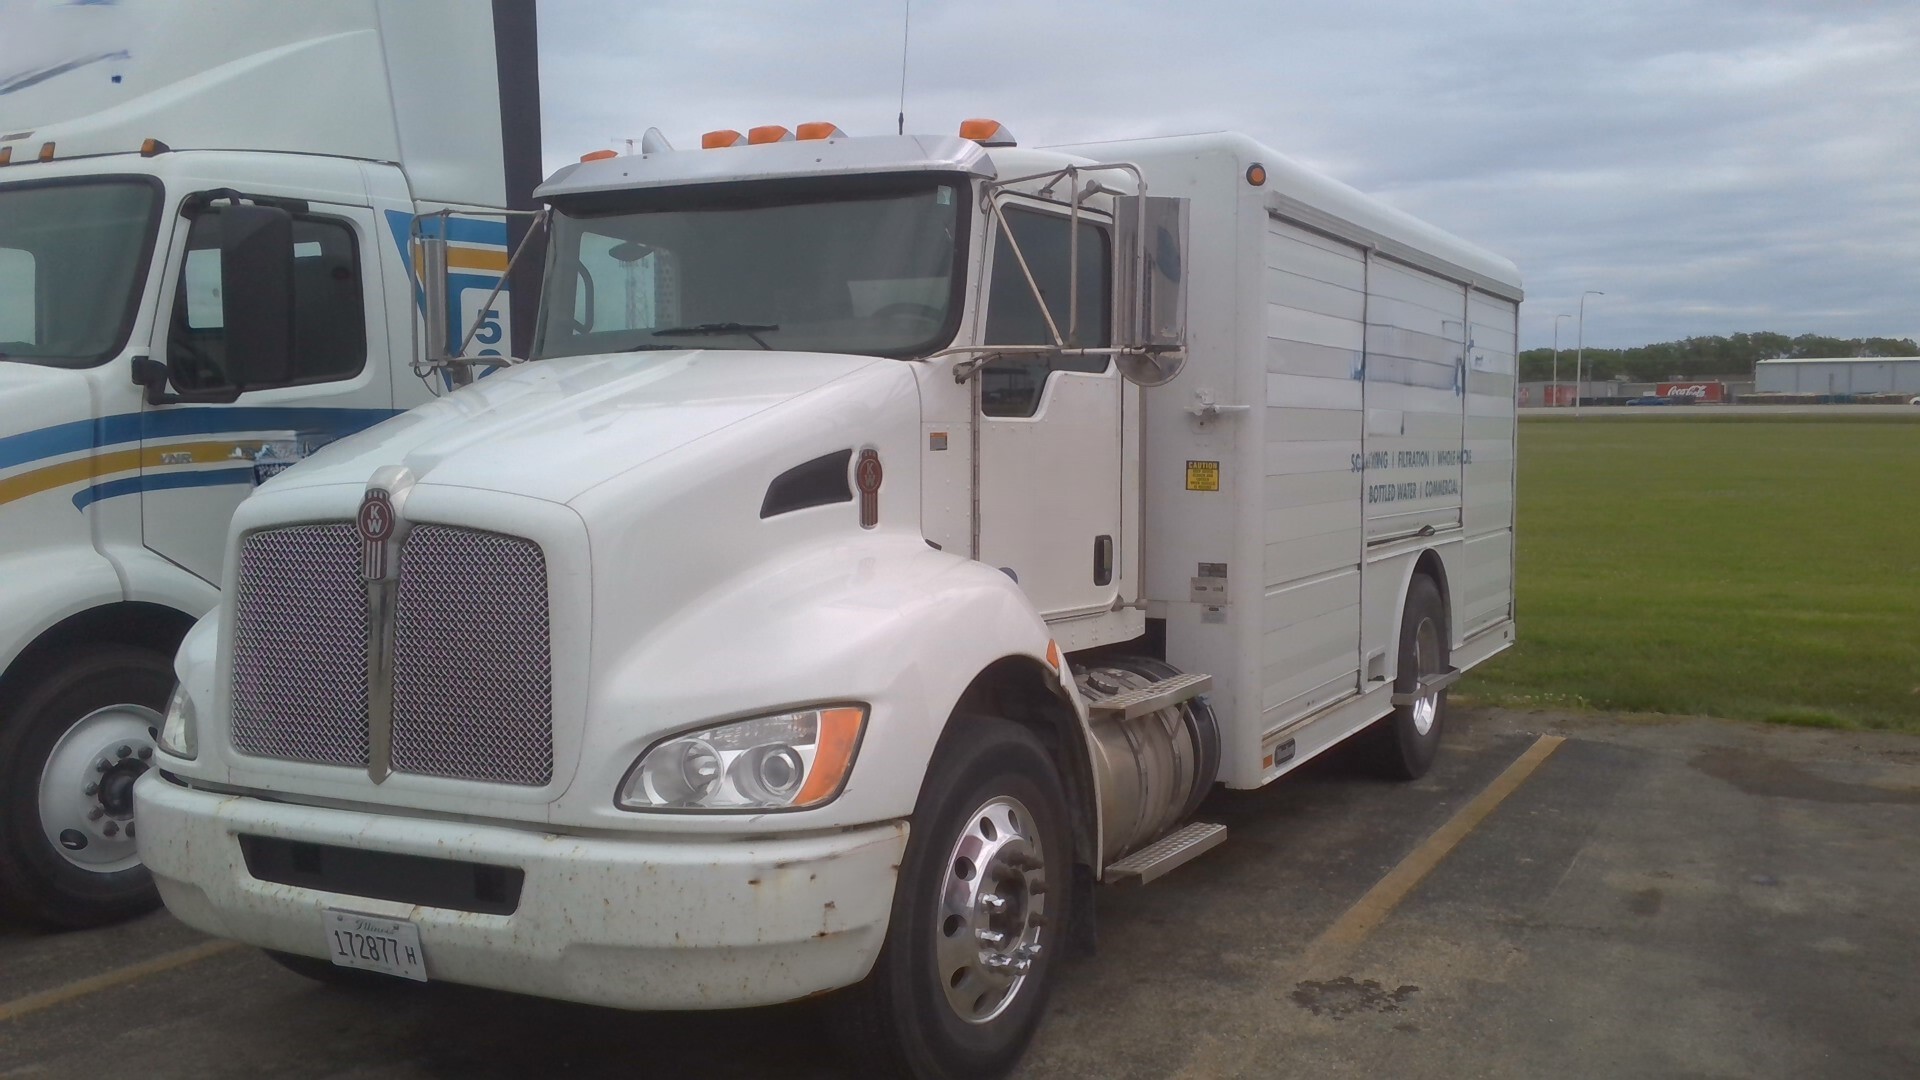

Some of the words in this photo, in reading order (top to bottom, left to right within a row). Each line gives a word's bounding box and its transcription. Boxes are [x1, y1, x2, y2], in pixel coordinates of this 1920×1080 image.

[1188, 461, 1218, 470] CAUTION
[1398, 451, 1430, 468] FILTRATION
[1437, 450, 1456, 467] WHOLE
[1368, 483, 1396, 504] BOTTLED
[1397, 482, 1417, 500] WATER
[1425, 479, 1458, 498] COMMERCIAL
[335, 930, 400, 966] 172877
[404, 945, 417, 965] H
